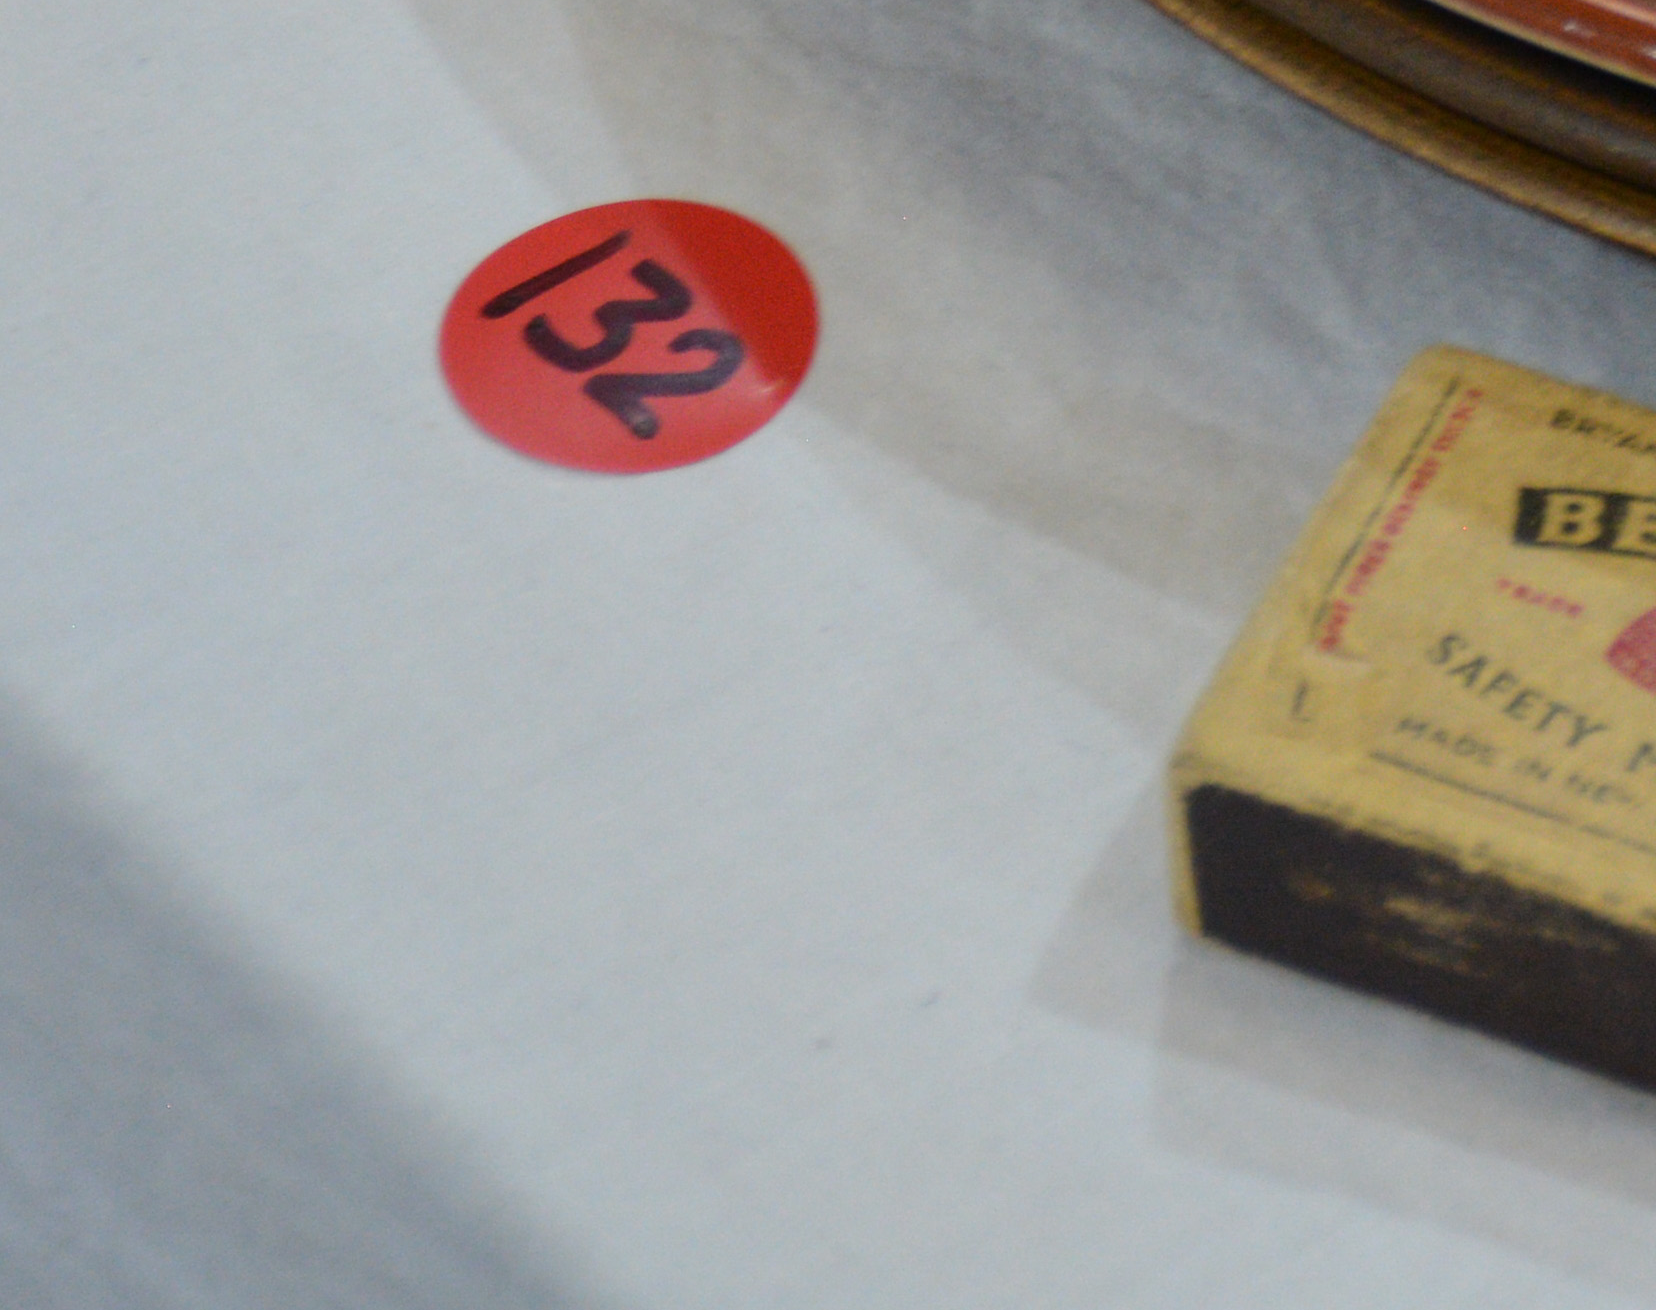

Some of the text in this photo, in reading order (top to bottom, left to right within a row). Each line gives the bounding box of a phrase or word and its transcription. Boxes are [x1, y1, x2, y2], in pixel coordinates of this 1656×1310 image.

[480, 228, 746, 442] 132
[1395, 714, 1498, 768] MADE
[1423, 631, 1610, 749] SAFETY
